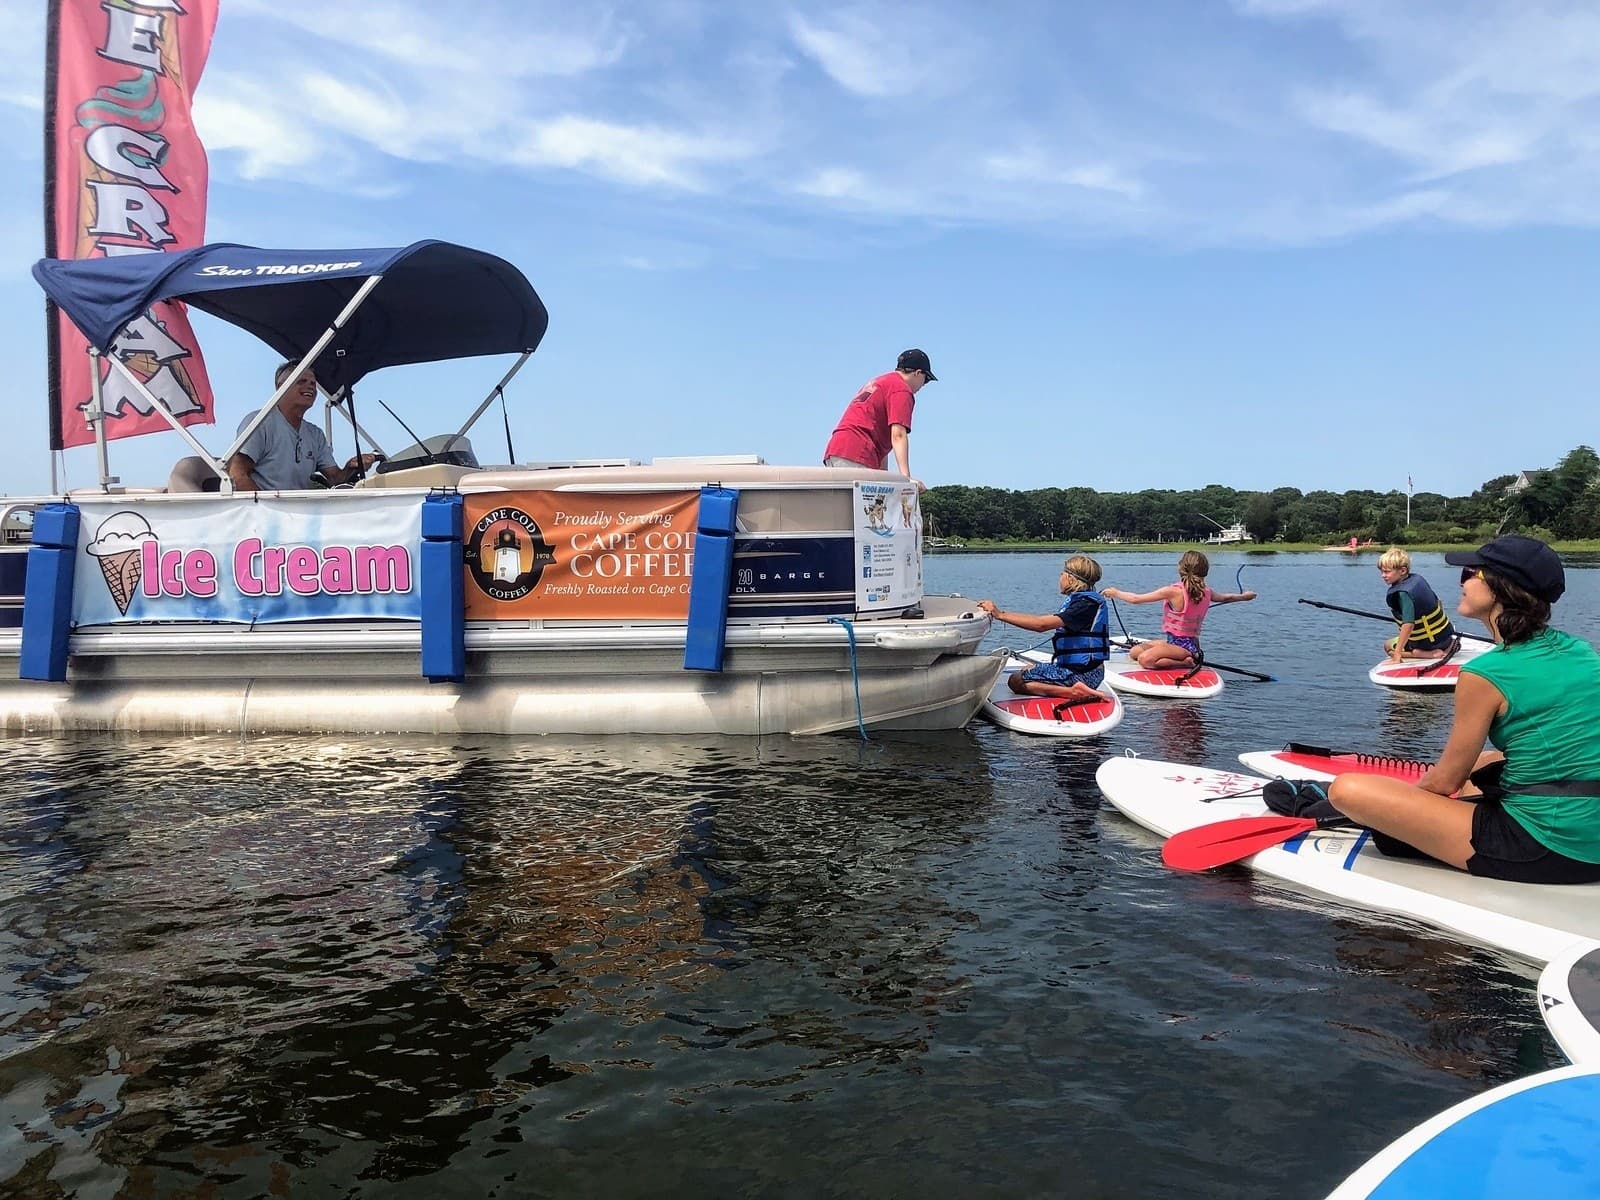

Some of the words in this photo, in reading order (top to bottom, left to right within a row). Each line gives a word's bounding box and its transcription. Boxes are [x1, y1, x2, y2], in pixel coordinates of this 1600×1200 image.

[76, 124, 206, 420] CRAM
[194, 265, 252, 276] Sun
[255, 261, 362, 275] TRACKER
[478, 509, 507, 532] CAPE
[511, 511, 536, 533] COD
[554, 511, 612, 528] Proudly
[616, 510, 674, 527] Serving
[570, 532, 637, 551] CAPE
[142, 540, 217, 597] Ice
[233, 537, 410, 596] Cream
[739, 568, 753, 585] 20
[760, 572, 824, 580] BARGE
[489, 585, 528, 598] COFFEE
[544, 583, 584, 596] Freshly
[587, 584, 629, 595] Roasted
[631, 585, 645, 594] on
[649, 584, 676, 596] Cape
